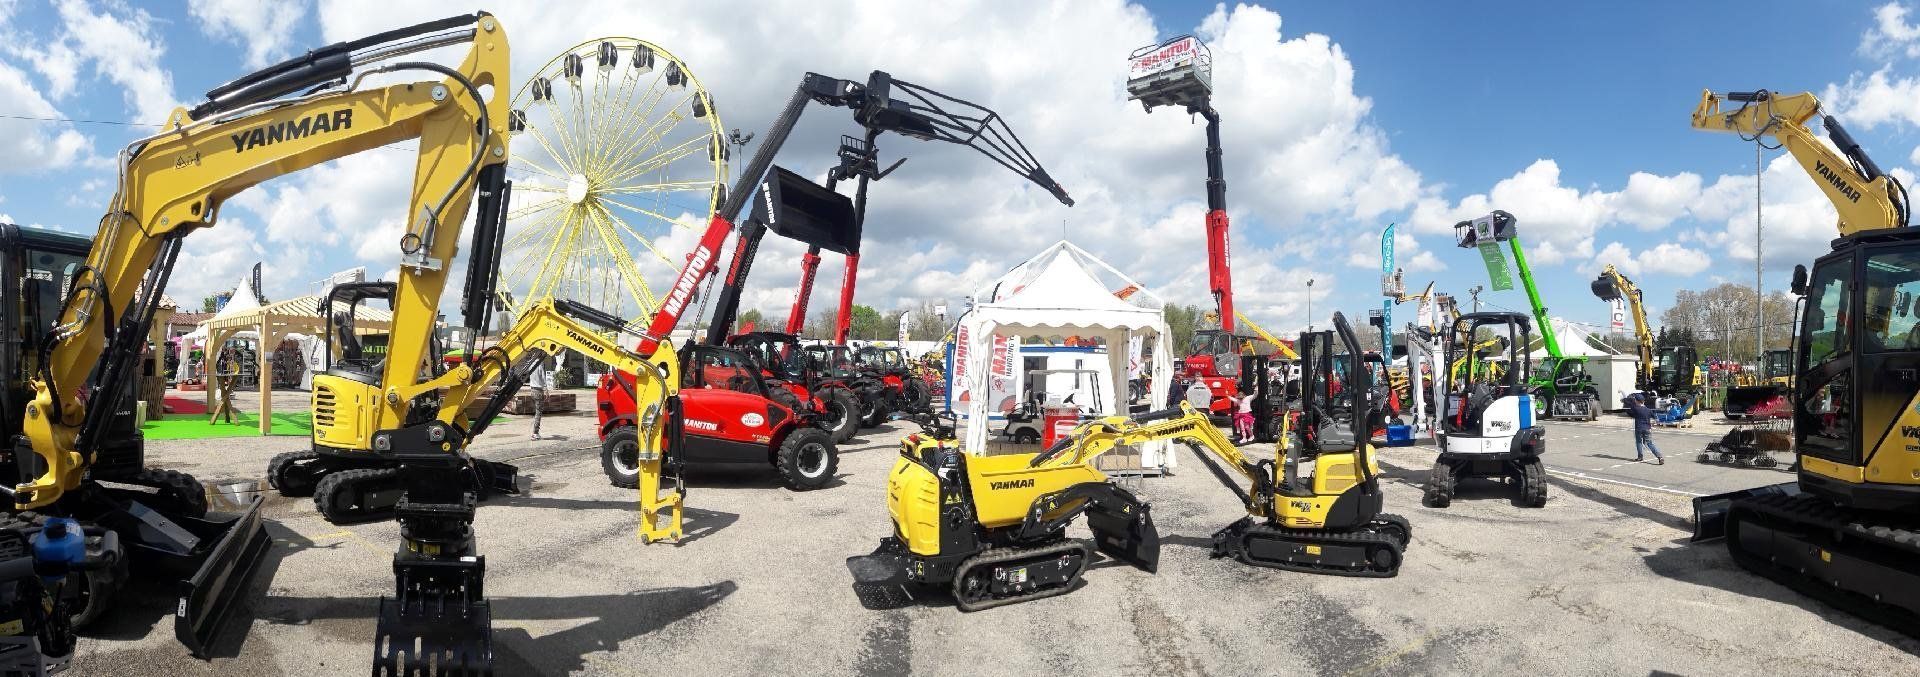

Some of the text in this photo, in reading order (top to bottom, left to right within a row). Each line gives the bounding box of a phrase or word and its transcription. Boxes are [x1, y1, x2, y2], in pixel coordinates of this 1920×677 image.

[1141, 40, 1191, 67] MANITOU
[231, 108, 353, 154] YANMAR
[1815, 160, 1862, 203] YANMAR
[664, 245, 712, 317] MANITOU
[566, 328, 605, 355] YANMAR
[956, 324, 969, 377] MANITOU
[1006, 343, 1016, 378] HANDLING
[1156, 423, 1195, 436] YANMAR
[990, 478, 1035, 490] YANMAR
